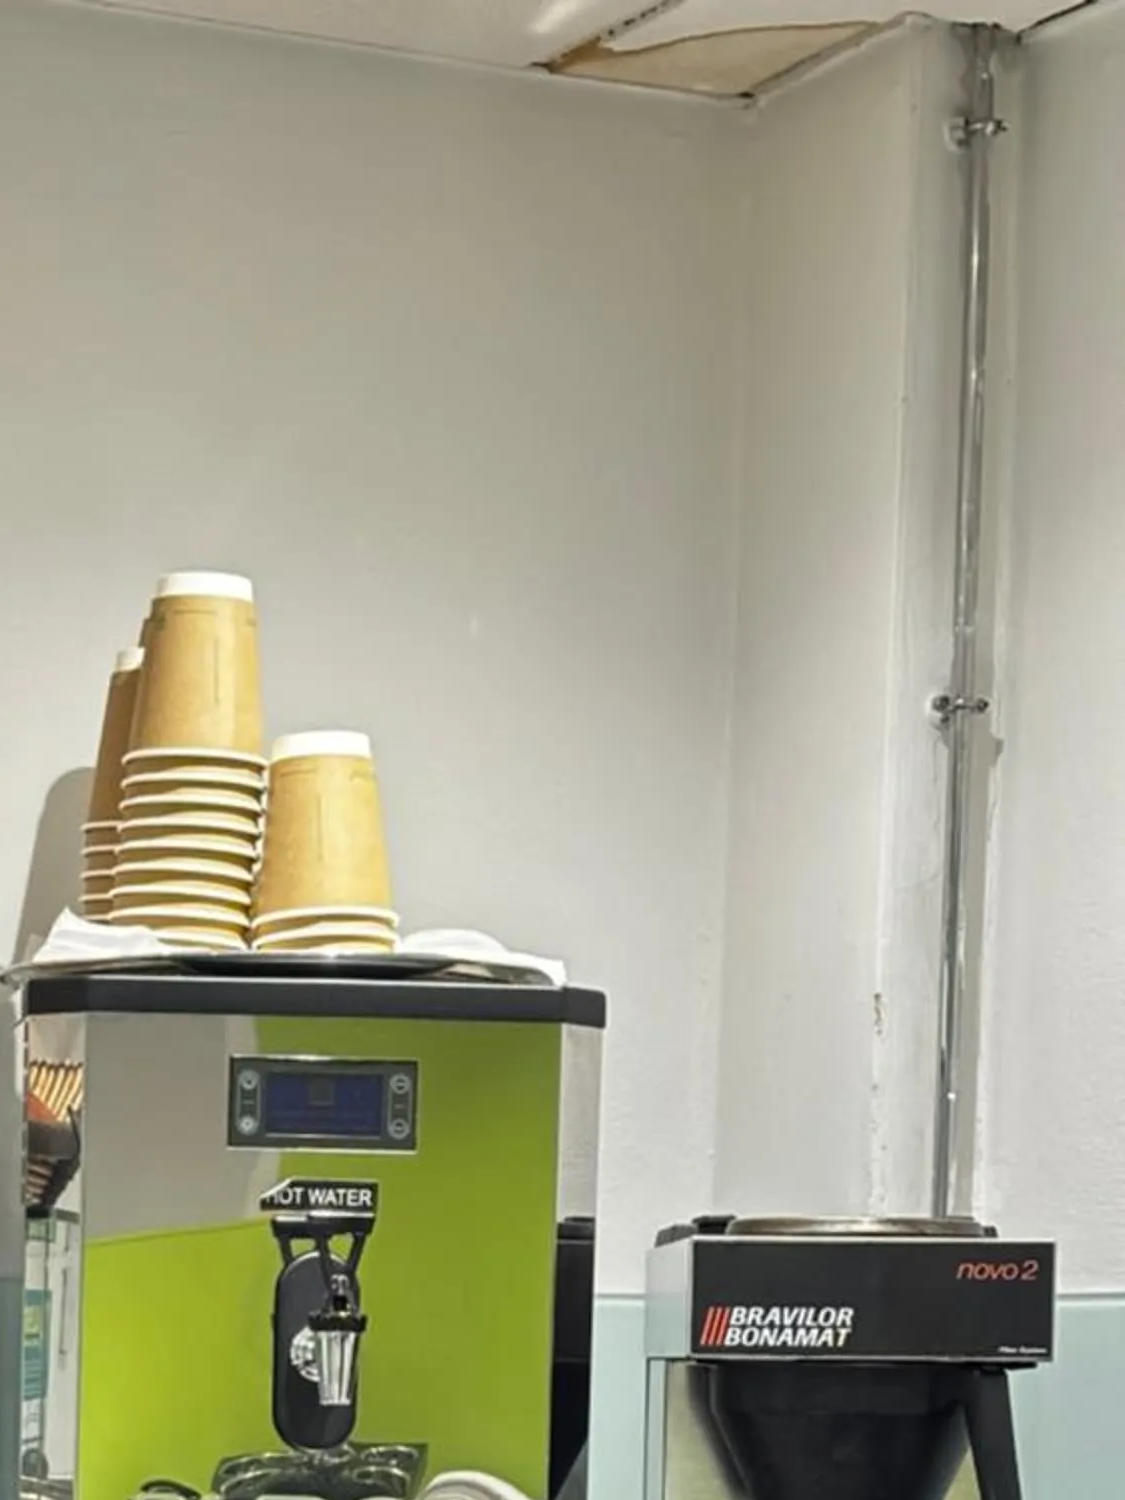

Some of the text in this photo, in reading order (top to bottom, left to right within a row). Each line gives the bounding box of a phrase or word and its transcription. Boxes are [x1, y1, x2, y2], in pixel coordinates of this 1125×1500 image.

[307, 1188, 372, 1206] WATER
[730, 1307, 854, 1326] BRAVILOR
[725, 1327, 851, 1348] BONAMAT
